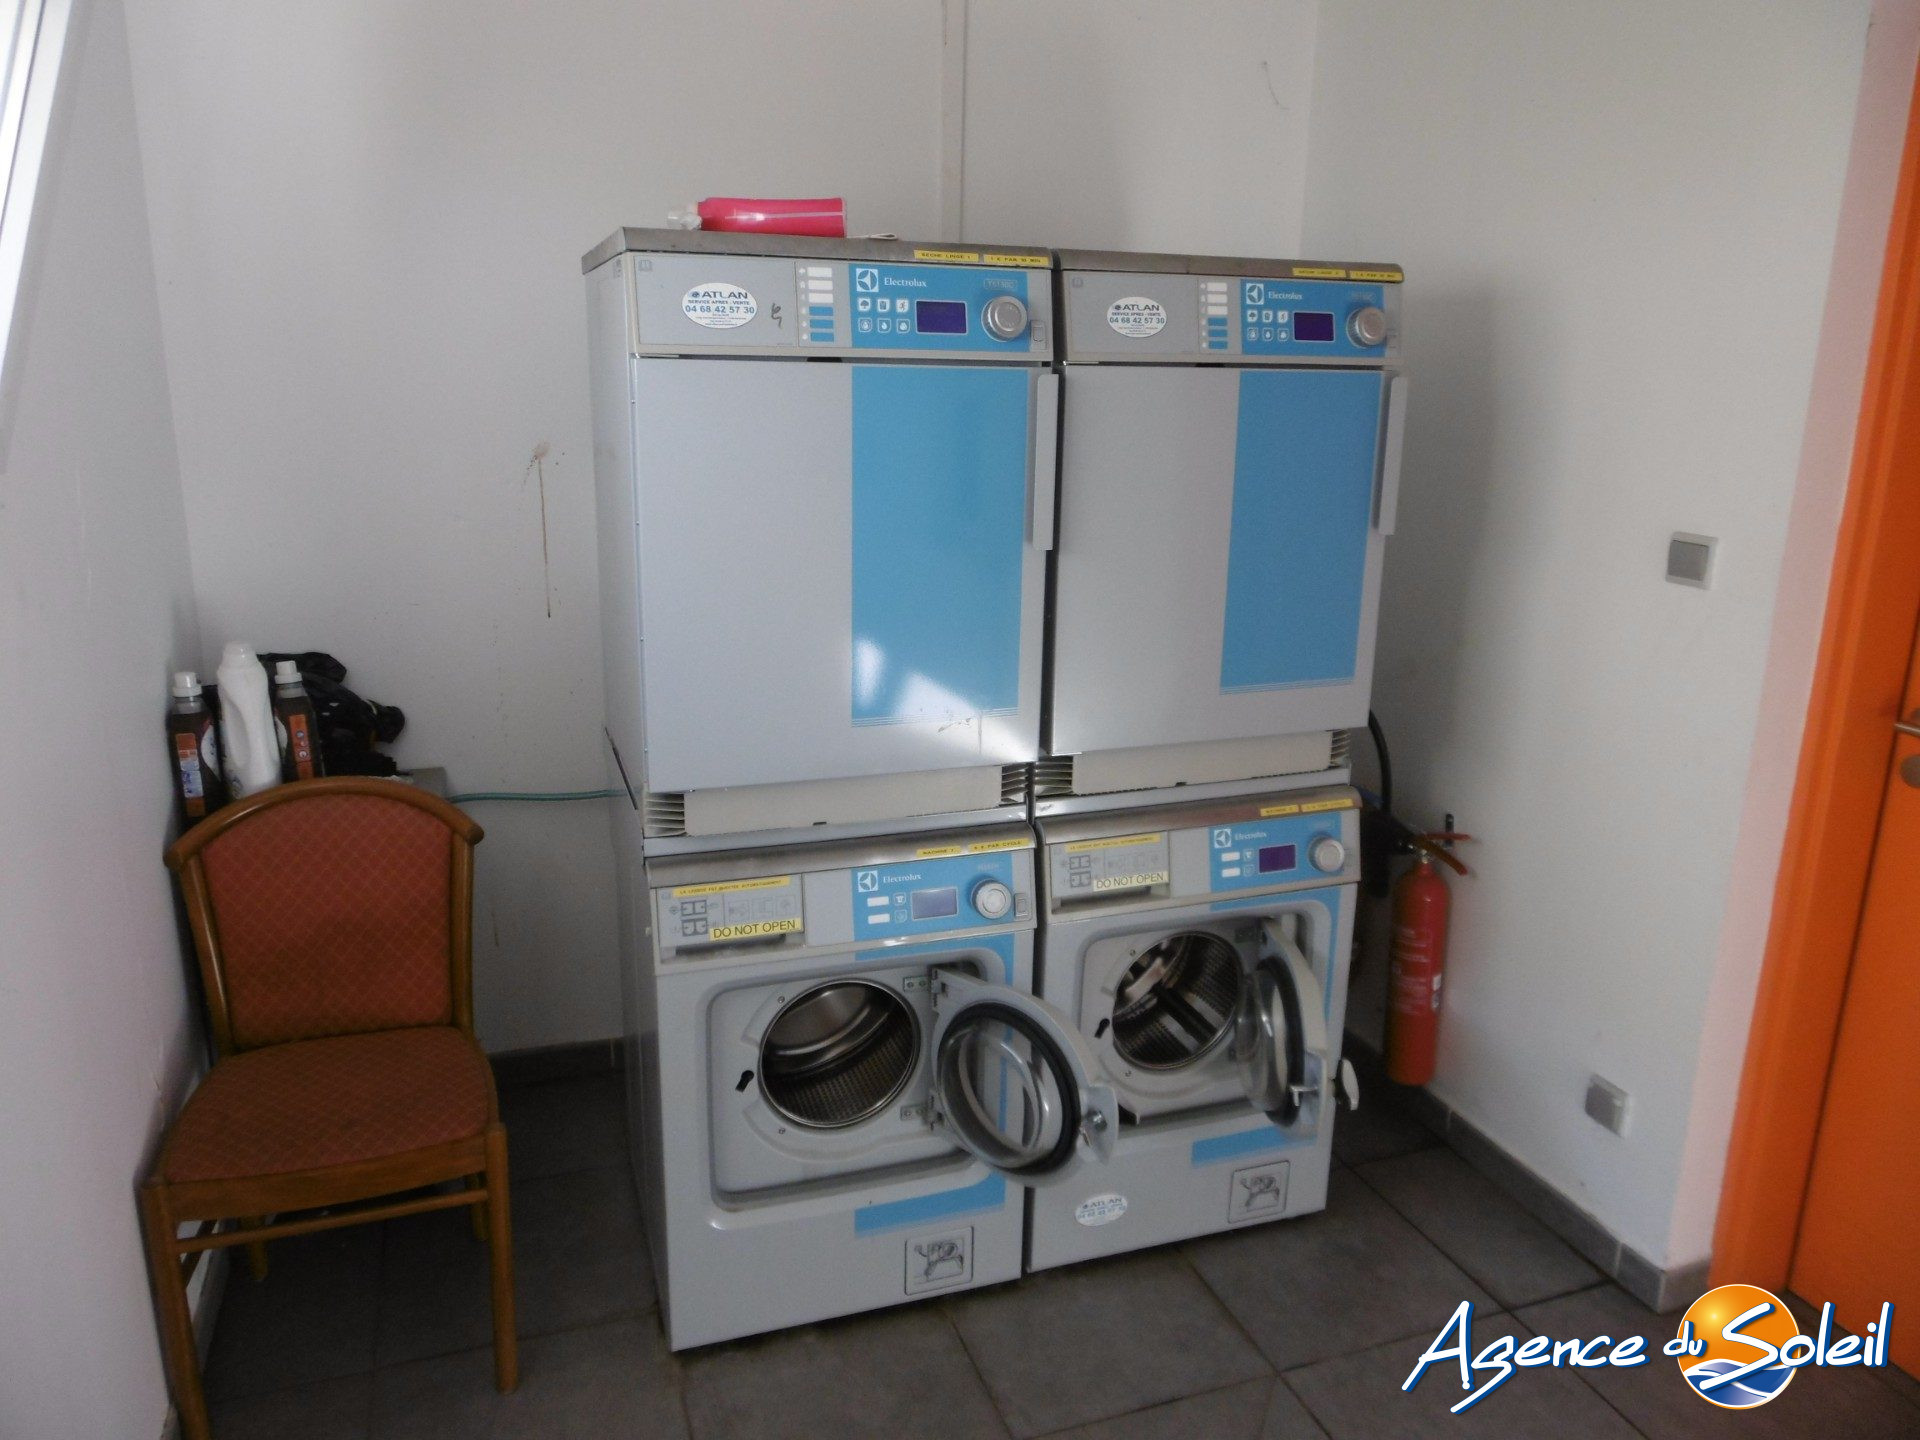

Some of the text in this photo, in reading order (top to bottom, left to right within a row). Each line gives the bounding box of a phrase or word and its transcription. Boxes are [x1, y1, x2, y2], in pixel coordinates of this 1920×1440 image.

[884, 277, 927, 288] Electrolux
[702, 291, 748, 299] ATLAN
[1268, 290, 1303, 300] Electrolux
[685, 305, 755, 314] 04 68 42 57 30
[1122, 304, 1160, 312] ATLAN
[883, 873, 922, 884] Electrolux
[1096, 872, 1164, 889] DO NOT OPEN
[713, 919, 796, 939] DO NOT OPEN
